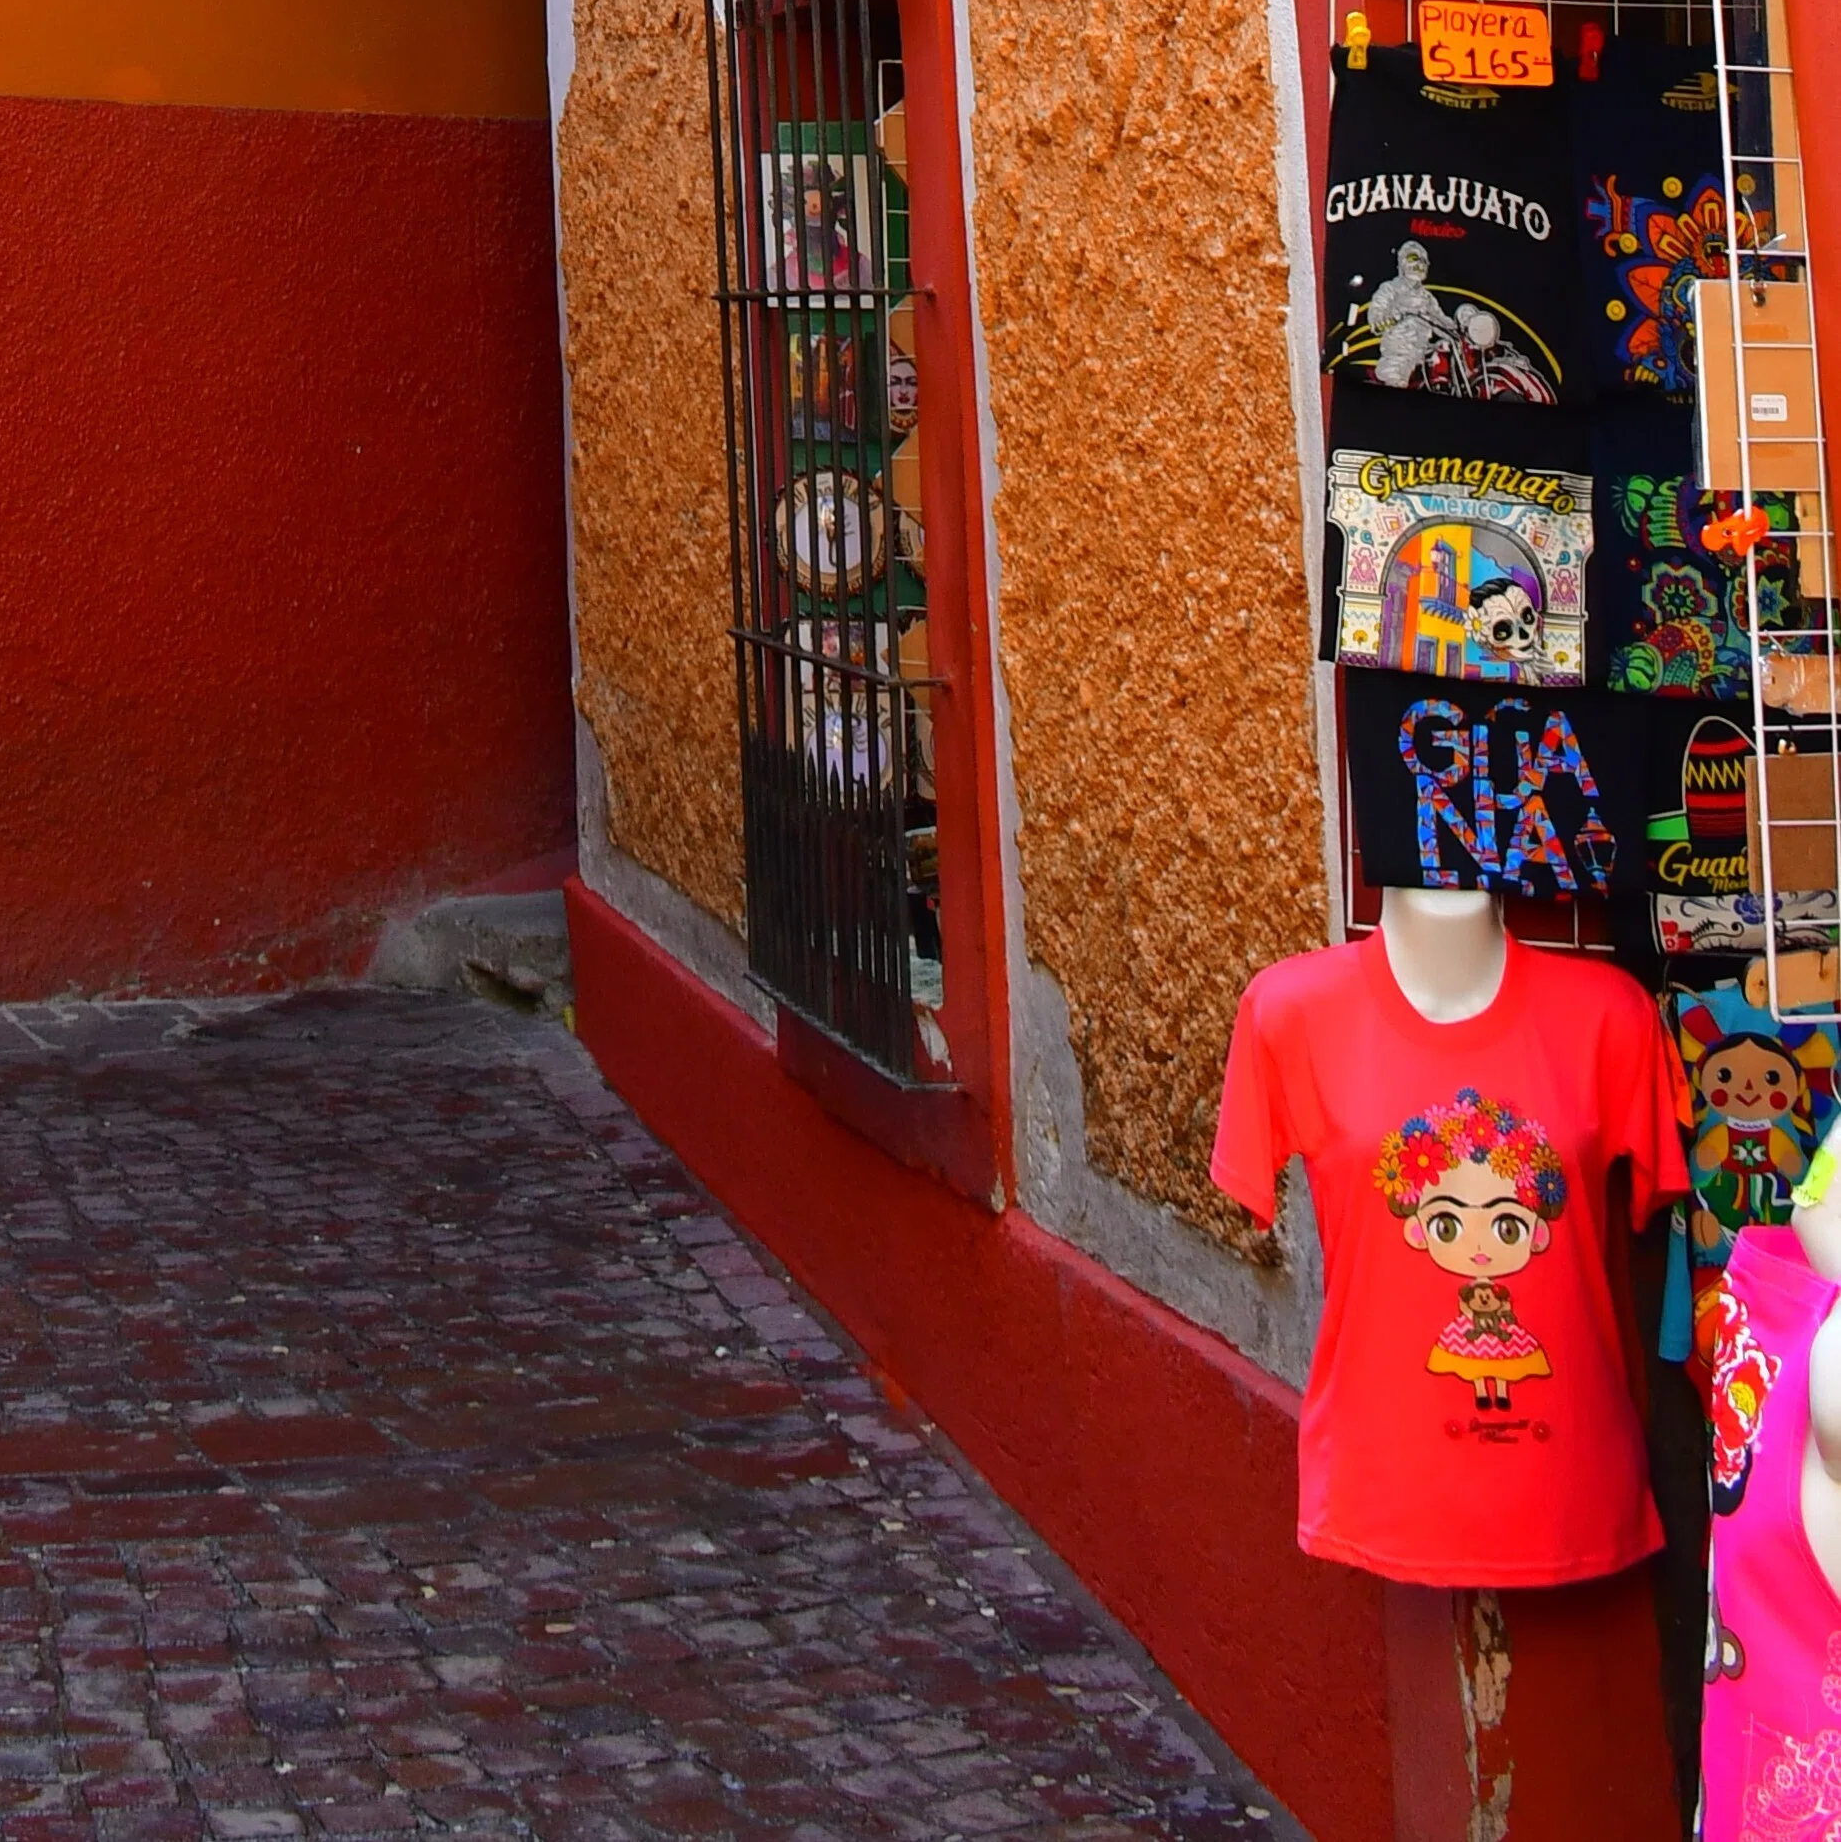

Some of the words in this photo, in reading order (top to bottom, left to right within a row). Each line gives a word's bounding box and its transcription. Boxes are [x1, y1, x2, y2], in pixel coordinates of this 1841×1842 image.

[1422, 5, 1534, 38] Playera
[1326, 174, 1551, 241] GUANAJUATO
[1360, 456, 1576, 515] Guanajuato
[1659, 841, 1749, 887] Guan
